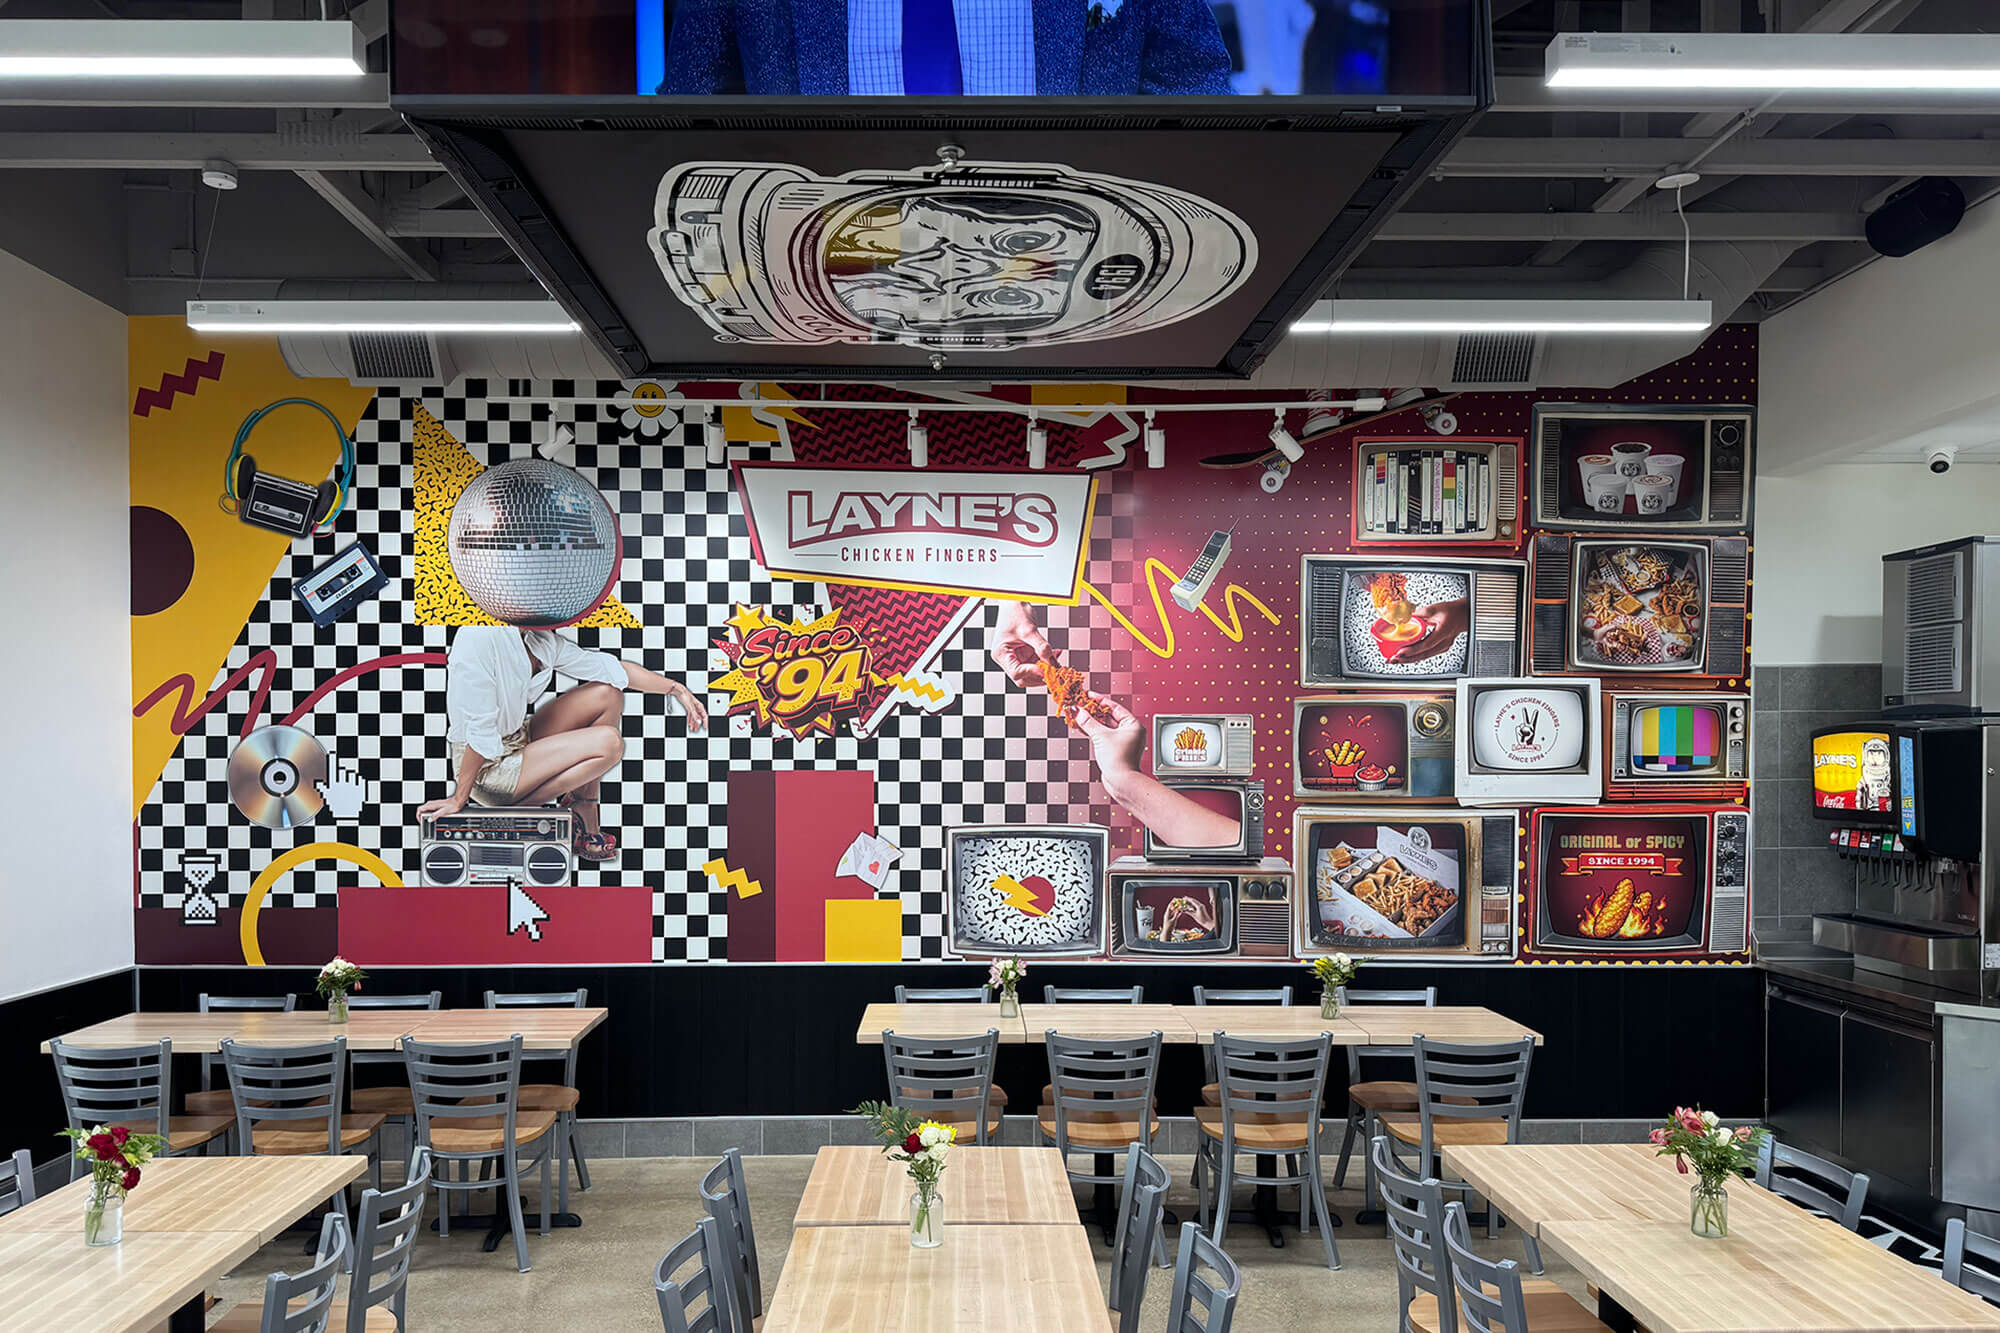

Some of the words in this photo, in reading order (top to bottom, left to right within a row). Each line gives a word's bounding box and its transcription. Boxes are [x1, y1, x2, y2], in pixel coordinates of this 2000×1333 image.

[1091, 264, 1138, 291] 1994
[788, 490, 1059, 549] LAYNE'S
[841, 546, 914, 562] CHICKEN
[925, 547, 998, 562] FINGERS
[740, 626, 858, 667] Since
[1511, 696, 1542, 706] CHICKEN
[1541, 702, 1560, 728] FINGERS
[1507, 752, 1528, 763] SINCE
[1814, 754, 1857, 768] LAYNE'S
[1560, 835, 1622, 849] ORIGINAL
[1625, 837, 1642, 849] or
[1646, 835, 1685, 849] SPICY
[1588, 857, 1625, 866] SINCE
[1627, 857, 1655, 866] 1994
